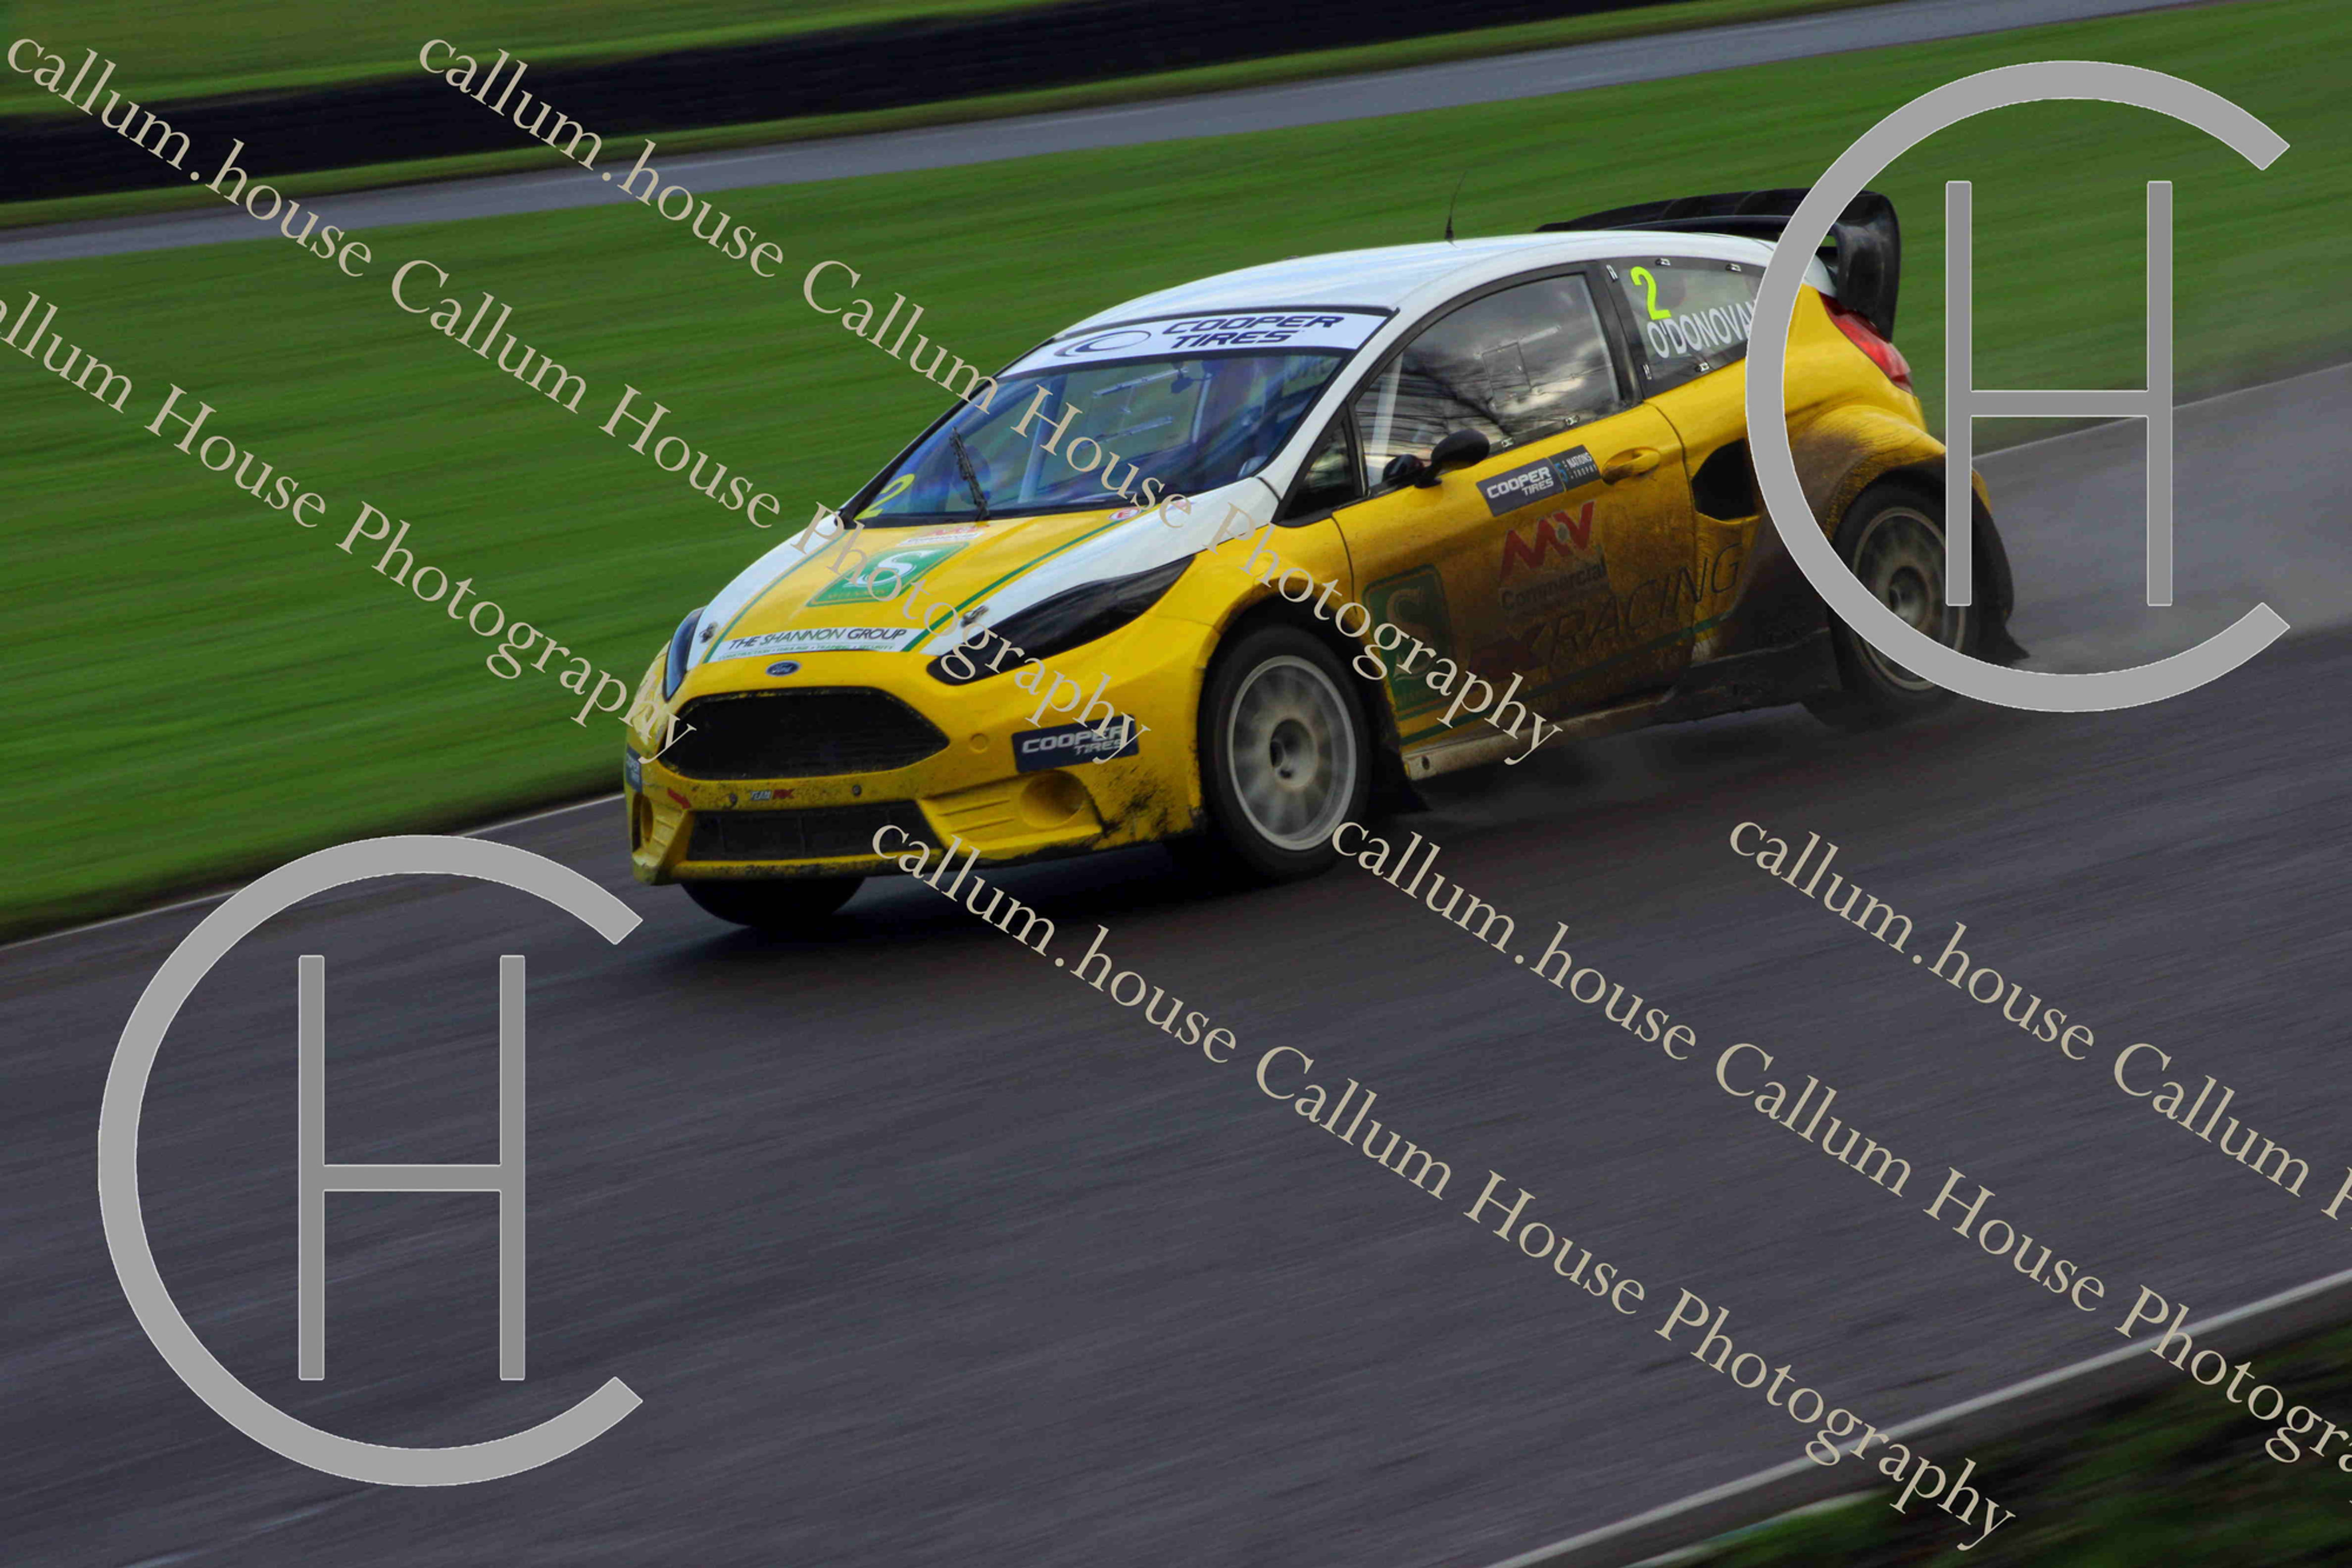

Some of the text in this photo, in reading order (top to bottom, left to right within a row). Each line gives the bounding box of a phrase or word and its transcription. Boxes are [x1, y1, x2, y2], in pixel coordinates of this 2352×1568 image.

[1630, 266, 1671, 320] 2
[1162, 315, 1344, 335] COOPER
[1171, 330, 1299, 349] TIRES
[1646, 299, 1758, 358] O'DONOVA
[1566, 451, 1592, 469] NATIONS
[853, 473, 915, 520] 2
[1486, 466, 1551, 499] COOPER
[1521, 477, 1554, 496] TIRES
[1499, 546, 1608, 611] Commercial
[1549, 541, 1743, 669] RACING
[729, 628, 907, 650] THE SHANNON GROUP
